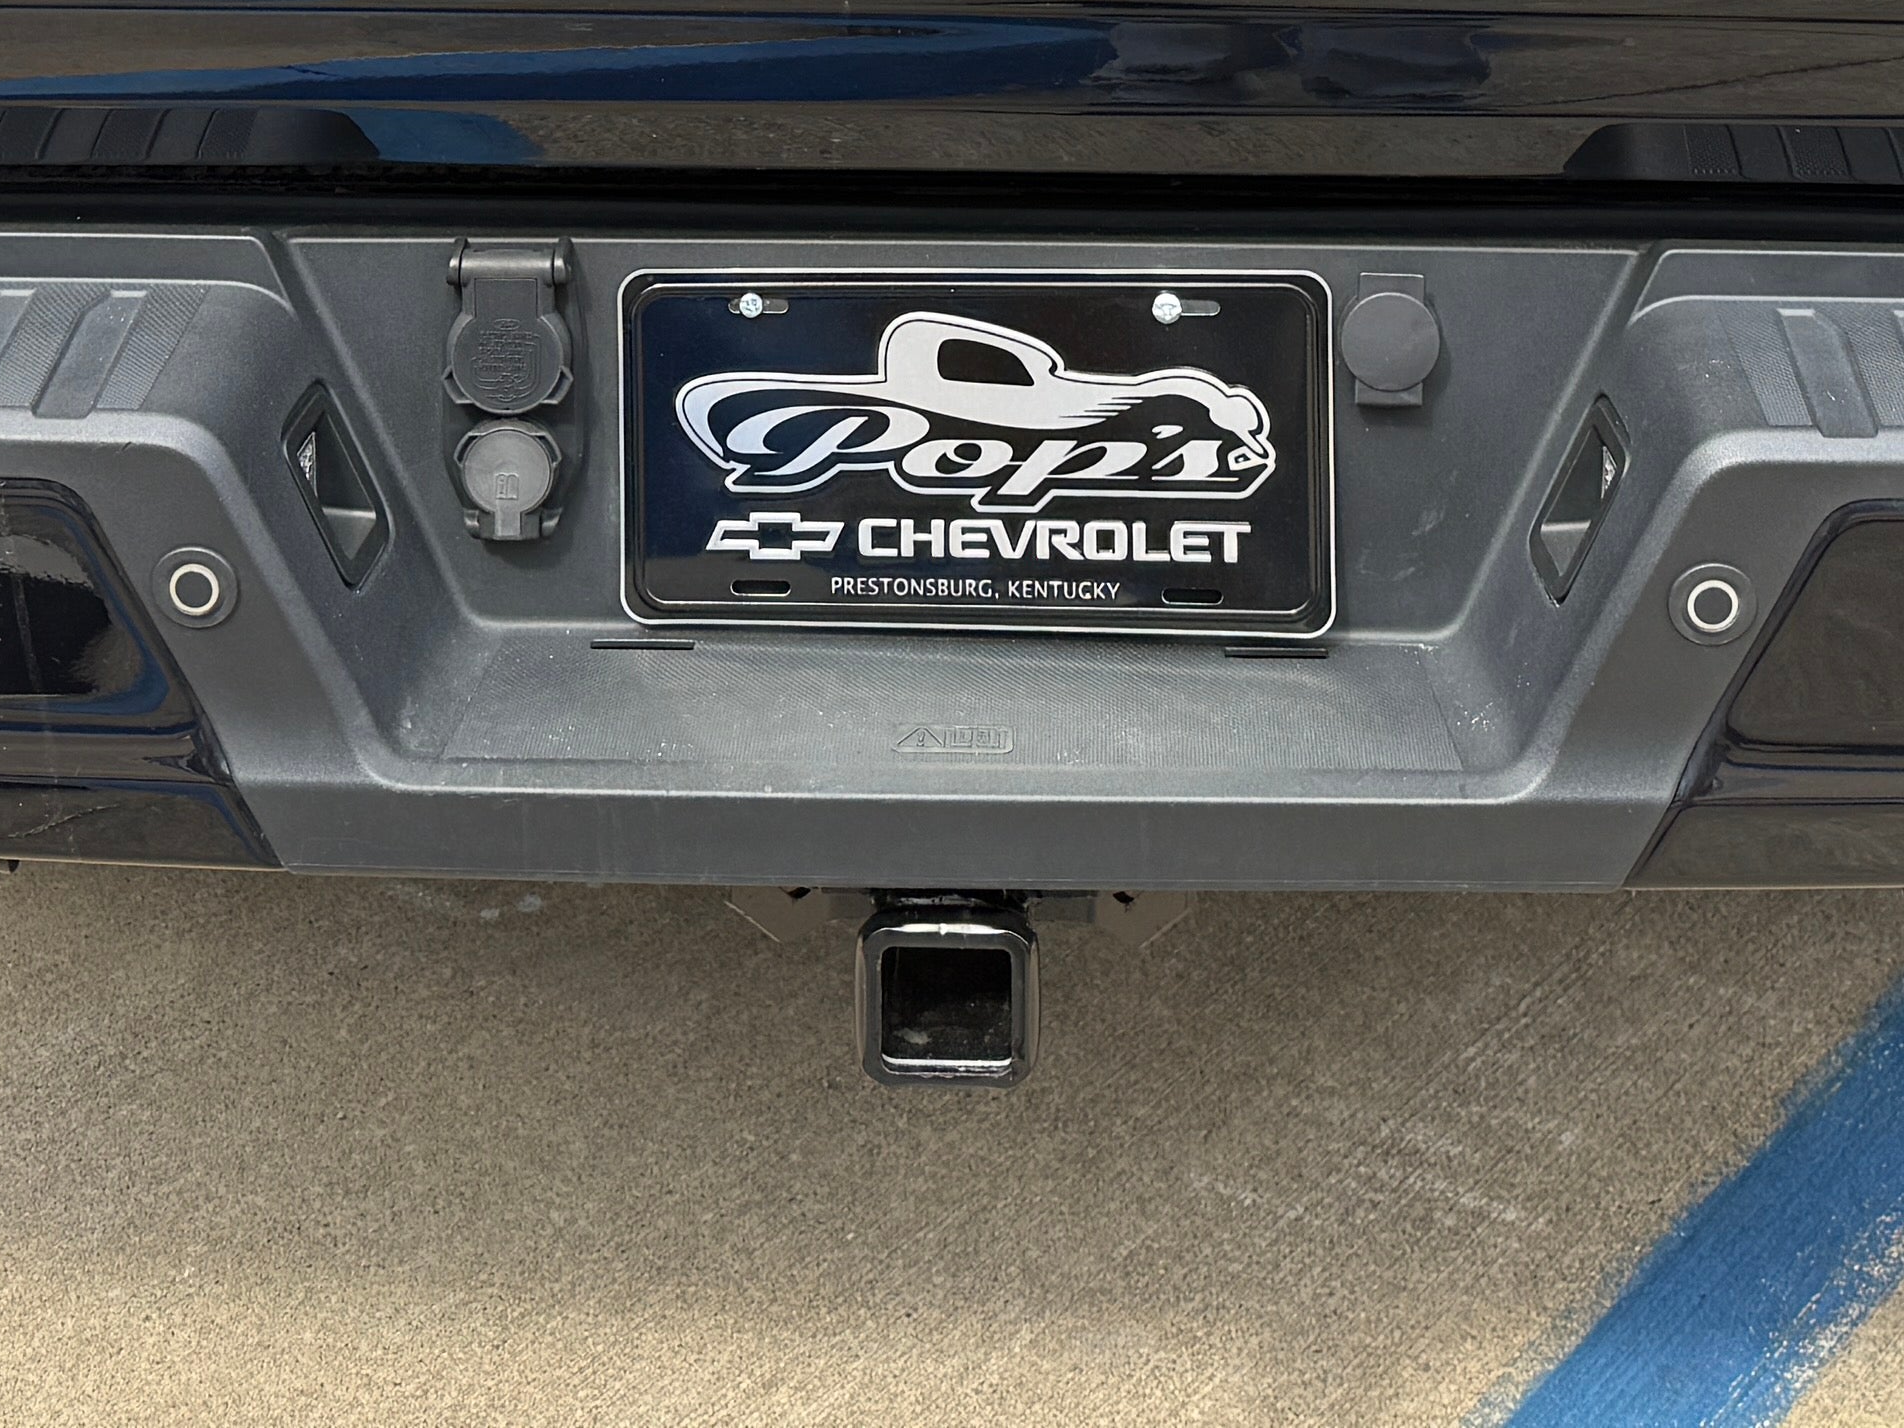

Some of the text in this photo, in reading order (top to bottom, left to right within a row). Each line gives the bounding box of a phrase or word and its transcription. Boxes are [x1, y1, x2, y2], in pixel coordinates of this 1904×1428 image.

[726, 404, 1240, 496] Pop's
[857, 517, 1252, 564] CHEVROLET
[830, 577, 1121, 600] PRESTONSBURG, KENTUCKY
